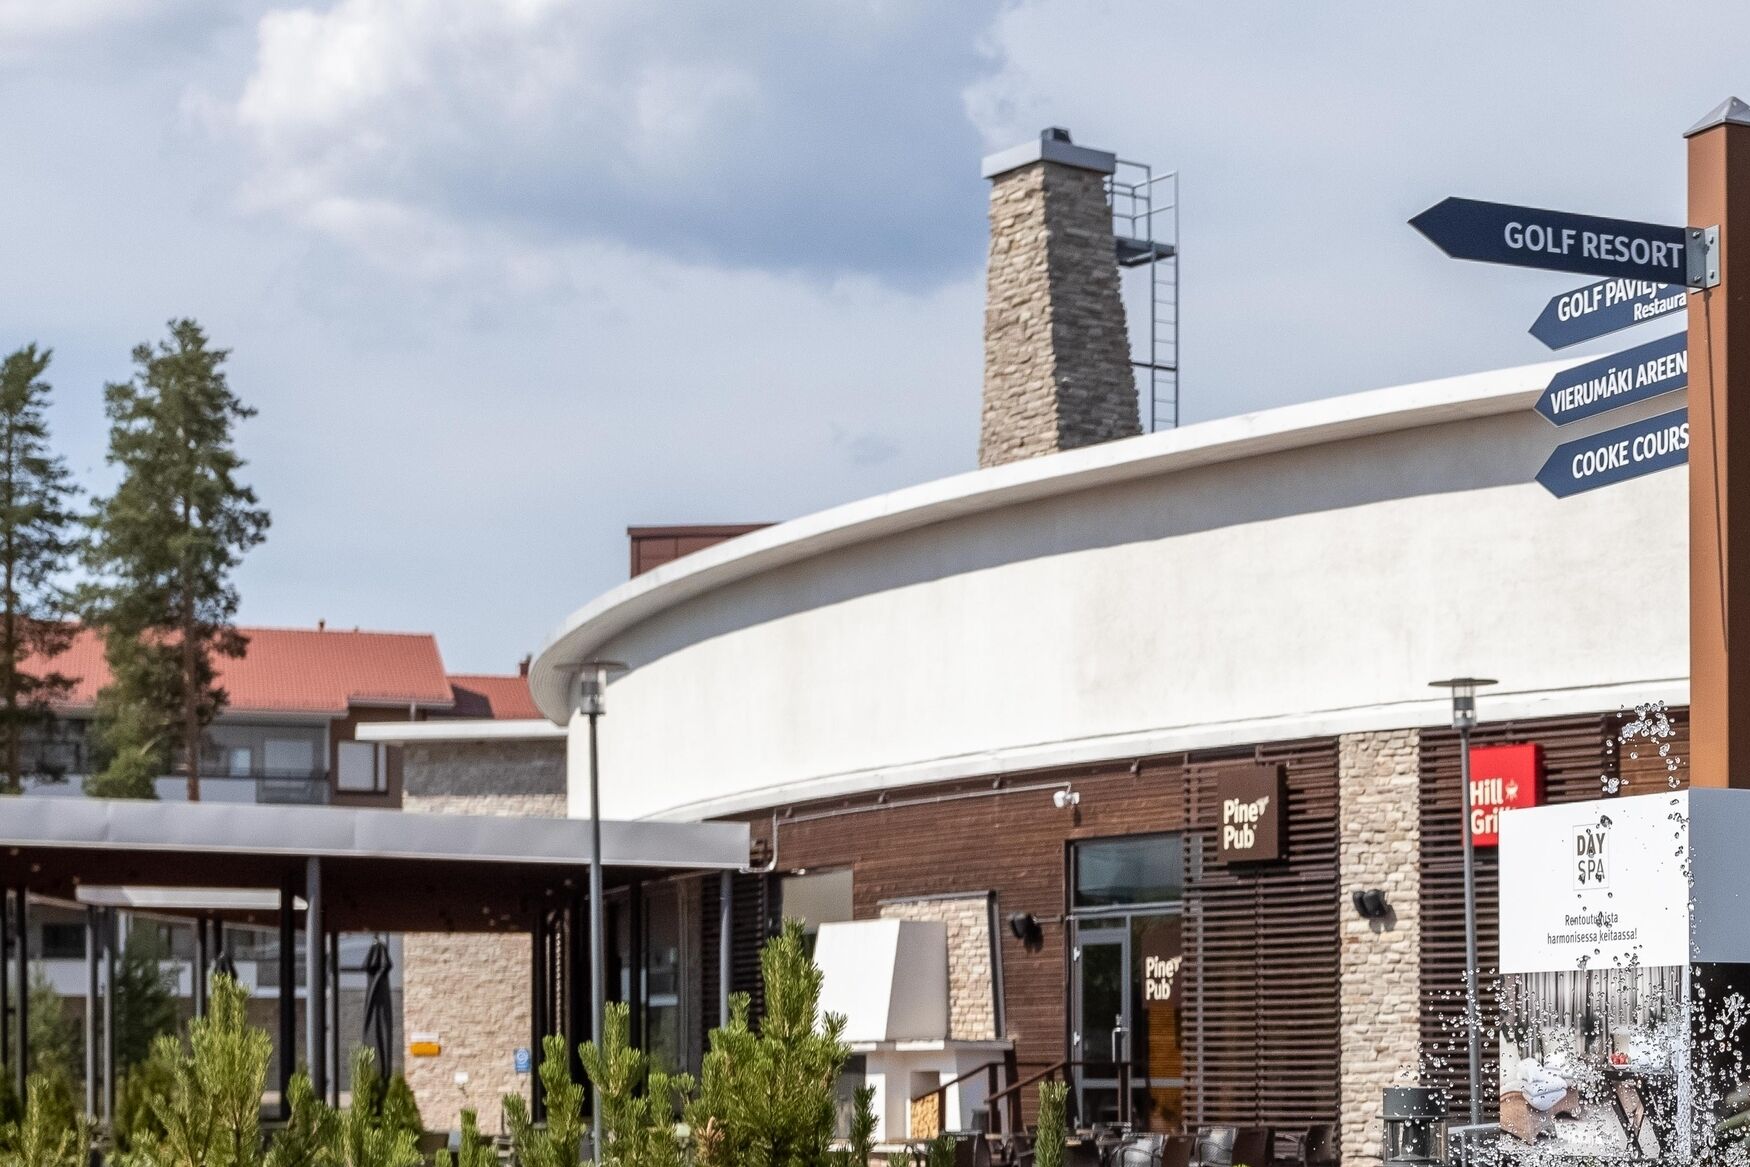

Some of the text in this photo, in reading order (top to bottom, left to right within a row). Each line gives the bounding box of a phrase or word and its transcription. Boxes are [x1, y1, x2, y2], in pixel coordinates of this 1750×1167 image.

[1504, 221, 1684, 268] GOLF RESORT
[1558, 278, 1669, 322] GOLF PAVILJ
[1550, 367, 1633, 415] VIERUMÄKI
[1572, 440, 1630, 479] COOKE
[1469, 778, 1504, 806] Hill
[1223, 798, 1259, 825] Pine
[1471, 806, 1511, 835] Gri
[1223, 823, 1255, 850] Pub
[1577, 832, 1606, 857] DAY
[1578, 859, 1606, 882] SPA
[1547, 927, 1638, 944] harmonisessa keitaassa!
[1145, 956, 1174, 978] Pine
[1145, 978, 1171, 1000] Pub
